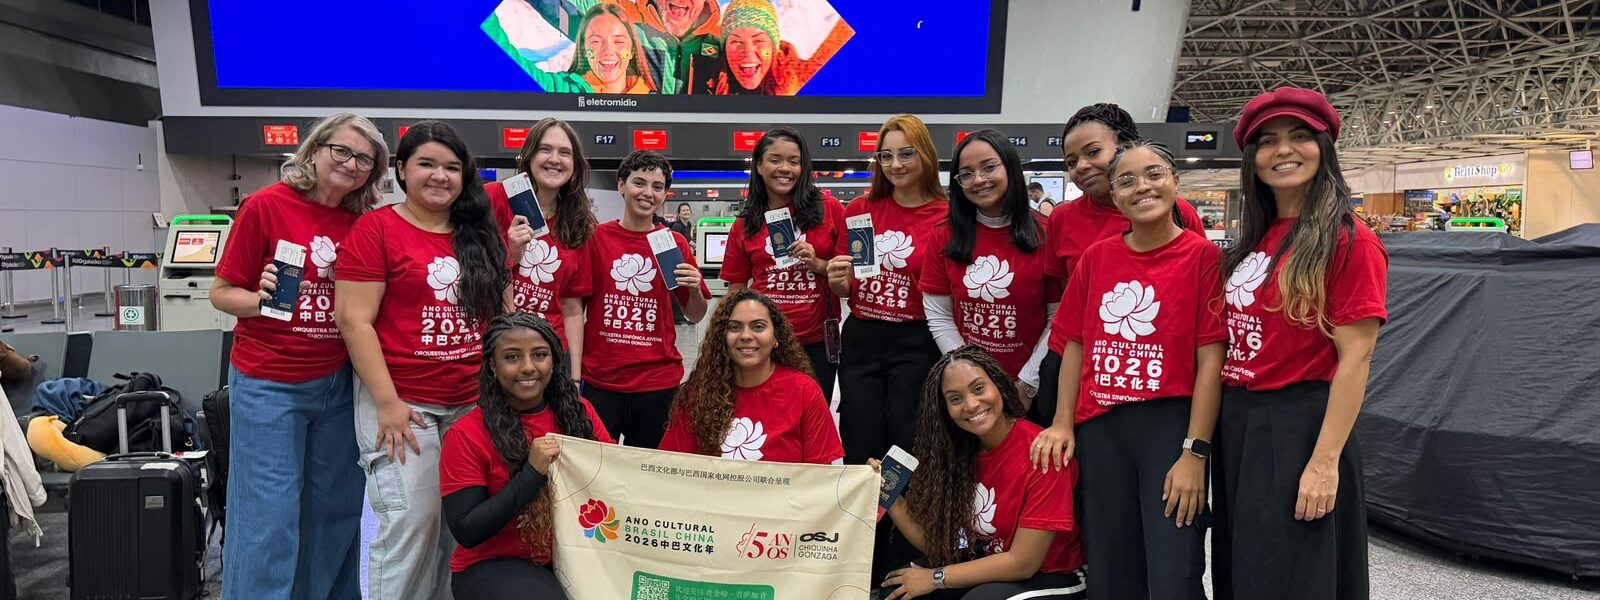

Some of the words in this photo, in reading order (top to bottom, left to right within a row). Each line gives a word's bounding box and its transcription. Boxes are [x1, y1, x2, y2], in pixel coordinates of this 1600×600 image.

[586, 98, 637, 106] eletromidia
[596, 135, 614, 144] F17
[822, 138, 840, 146] F15
[1009, 138, 1026, 146] F14
[1048, 138, 1062, 146] F1
[767, 270, 816, 282] 2026
[881, 271, 912, 282] ULTURAL
[766, 282, 817, 291] 中巴文化年
[887, 278, 910, 287] CHINA
[522, 282, 554, 296] CULTURAL
[858, 278, 910, 300] 2026
[532, 292, 552, 300] CHINA
[621, 295, 658, 304] CULTURAL
[858, 291, 907, 308] 中巴文化年
[299, 295, 330, 310] 20
[514, 293, 550, 312] 026
[604, 298, 630, 306] BRASIL
[634, 302, 658, 310] CHINA
[604, 304, 656, 322] 2026
[604, 318, 656, 332] 中巴文化年
[963, 310, 1016, 330] 2026
[964, 322, 1016, 339] 中巴文化年
[1093, 346, 1124, 356] BRASIL
[1129, 350, 1164, 359] CHINA
[1112, 341, 1164, 352] CULTURAL
[1092, 354, 1162, 378] 2026
[1094, 372, 1160, 392] 中巴文化年
[626, 516, 649, 526] ANO
[654, 520, 715, 534] CULTURAL
[625, 526, 670, 539] BRASIL
[676, 532, 715, 544] CHINA
[800, 532, 840, 543] OSJ
[798, 544, 838, 552] CHIQUINHA
[798, 551, 838, 560] GONZAGA
